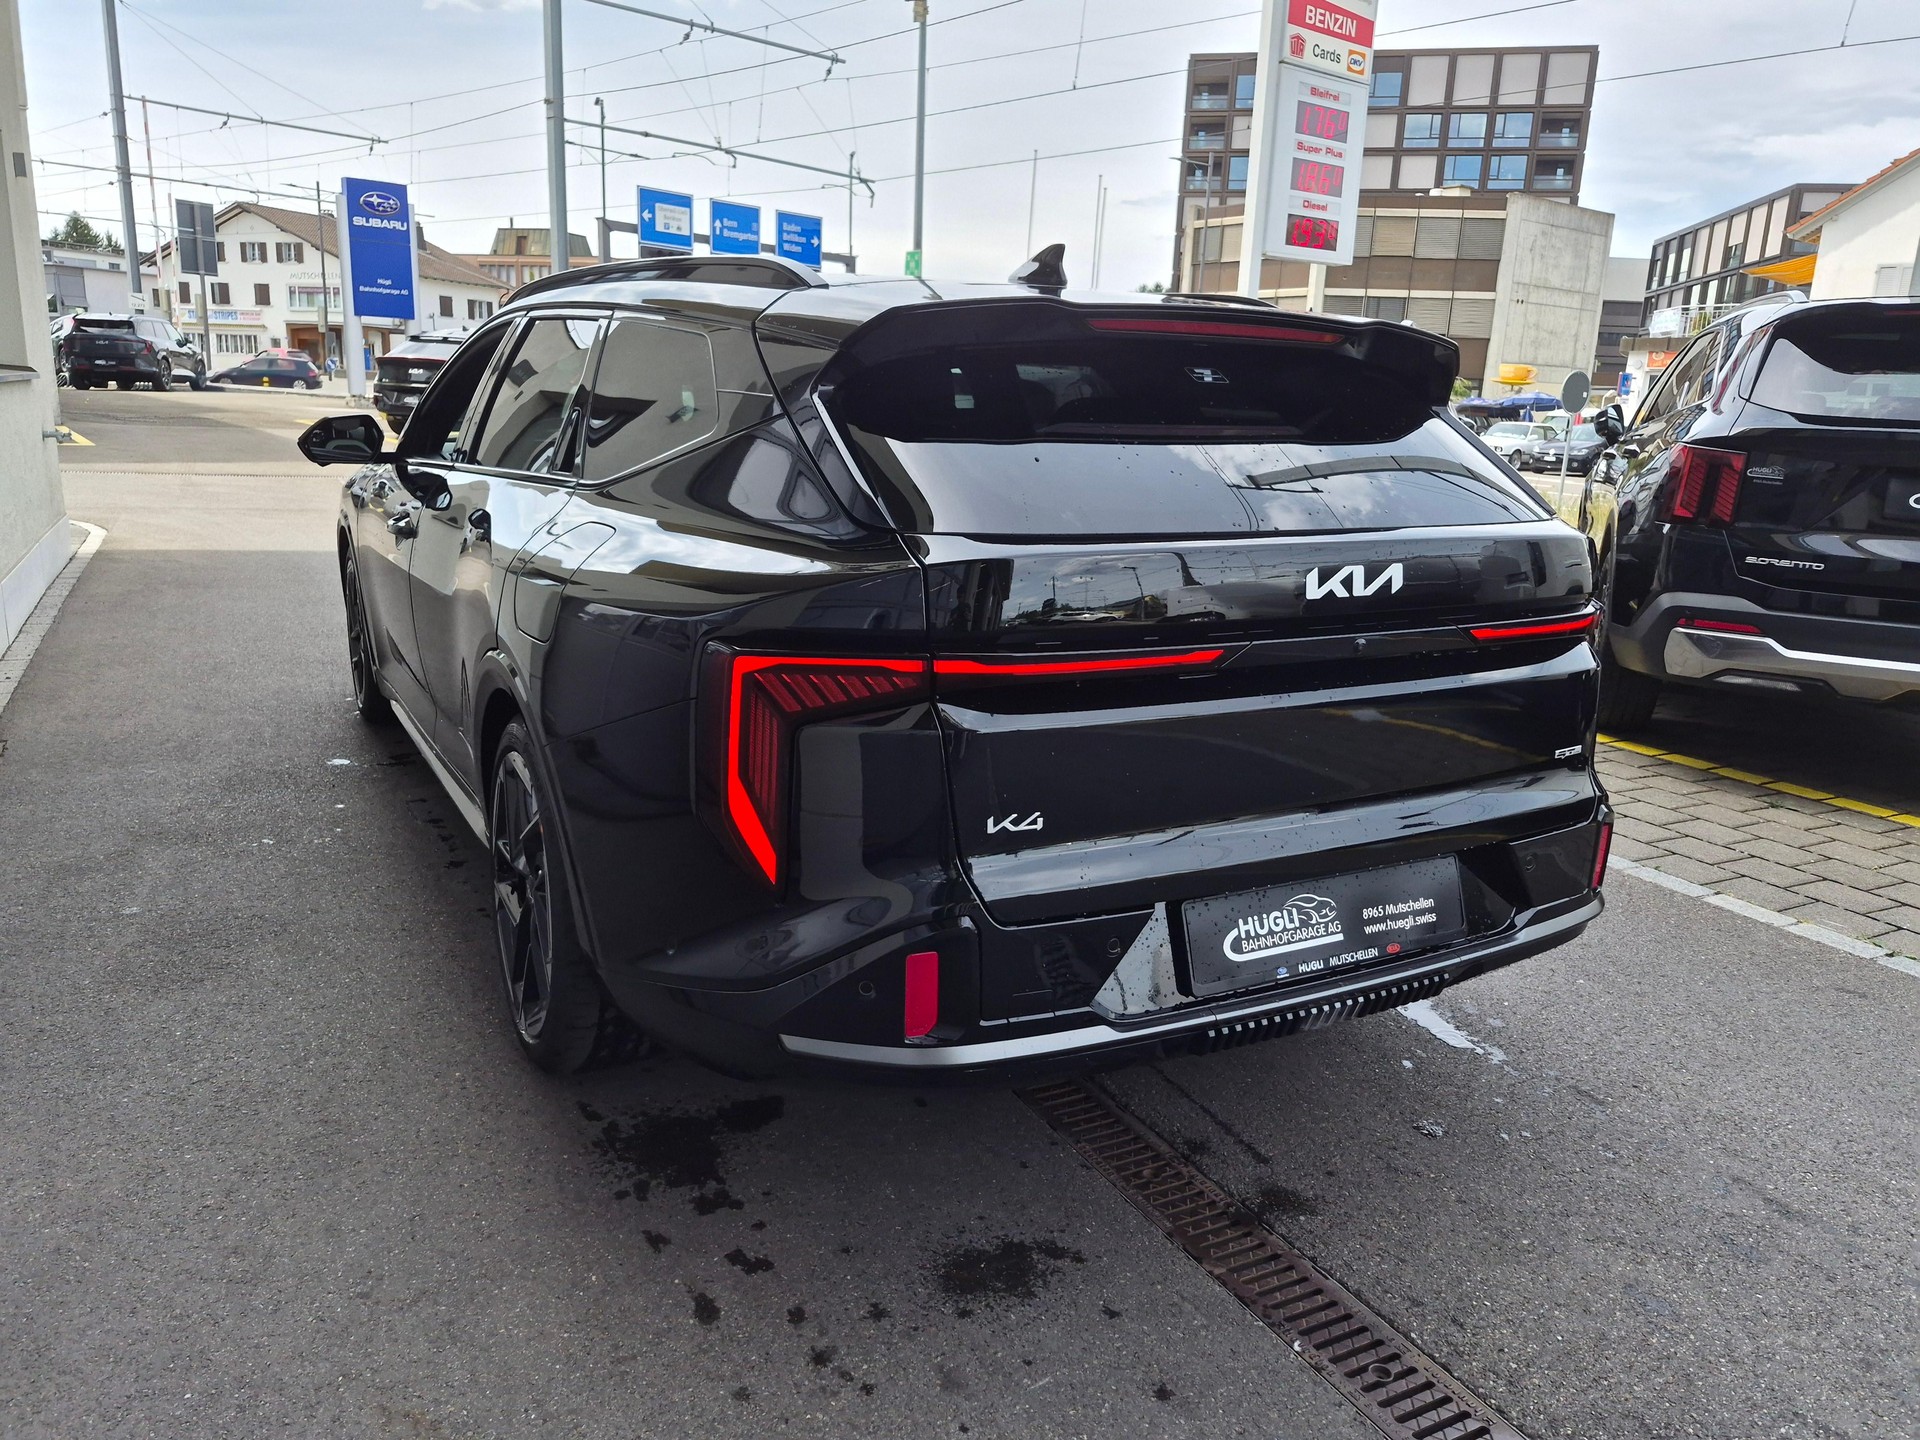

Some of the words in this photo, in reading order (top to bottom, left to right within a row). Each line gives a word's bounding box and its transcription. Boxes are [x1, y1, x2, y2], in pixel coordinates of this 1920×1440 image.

[1305, 4, 1357, 37] BENZIN
[1312, 43, 1341, 64] Cards
[1349, 57, 1363, 67] DKV
[1310, 86, 1340, 101] Bleifrei
[1297, 141, 1322, 154] Super
[1325, 147, 1343, 158] Plus
[1303, 199, 1328, 212] Diesel
[352, 216, 407, 231] SUBARU
[723, 218, 738, 228] Bern
[782, 222, 801, 232] Baden
[723, 228, 758, 241] Bremgarten
[1745, 556, 1825, 571] SORENTO
[1305, 563, 1403, 600] KIA
[987, 811, 1044, 834] K4
[1362, 905, 1384, 920] 8965
[1385, 898, 1434, 916] Mutschellen
[1238, 907, 1300, 939] HÜGLI
[1364, 912, 1437, 935] www.huegli.swiss
[1241, 925, 1326, 953] BAHNHOFGARAGE
[1328, 920, 1342, 935] AG
[1329, 947, 1379, 967] MUTSCHELLEN
